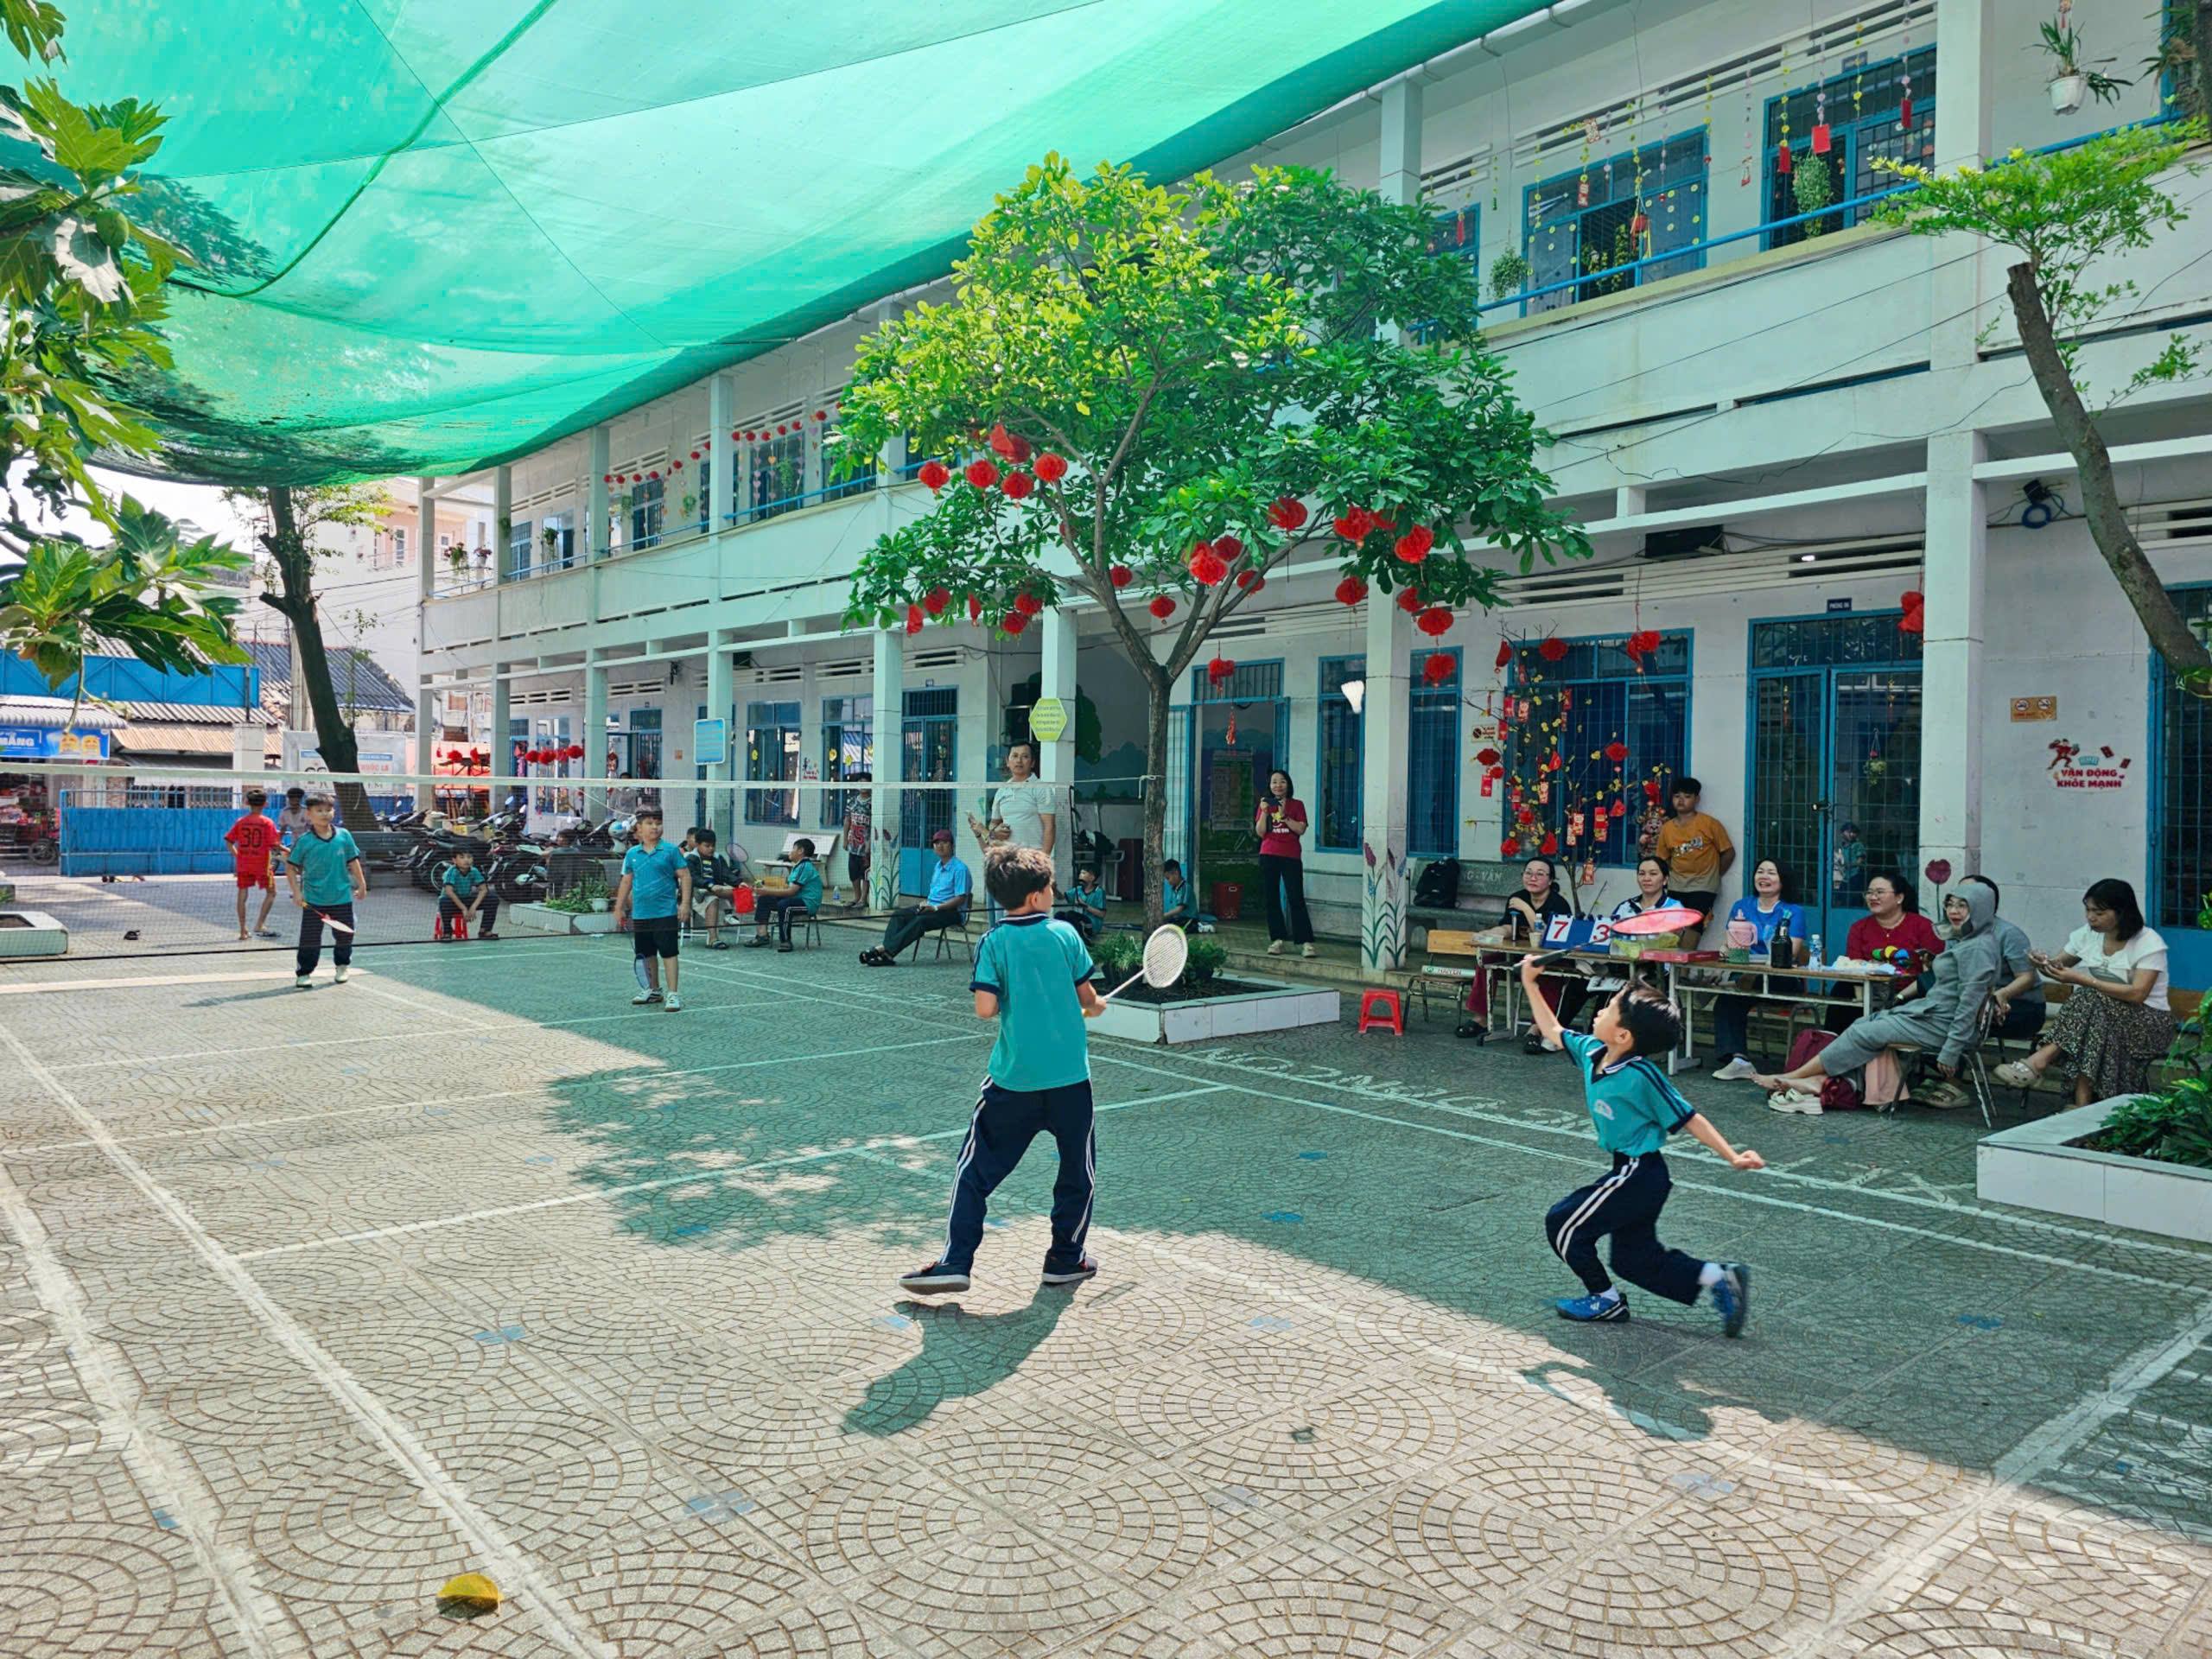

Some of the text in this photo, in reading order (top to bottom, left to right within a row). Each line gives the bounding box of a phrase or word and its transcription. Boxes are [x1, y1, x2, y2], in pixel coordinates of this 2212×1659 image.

[2088, 780, 2121, 790] MẠNH
[241, 827, 263, 848] 30
[1553, 920, 1568, 939] 7
[1592, 924, 1611, 943] 3
